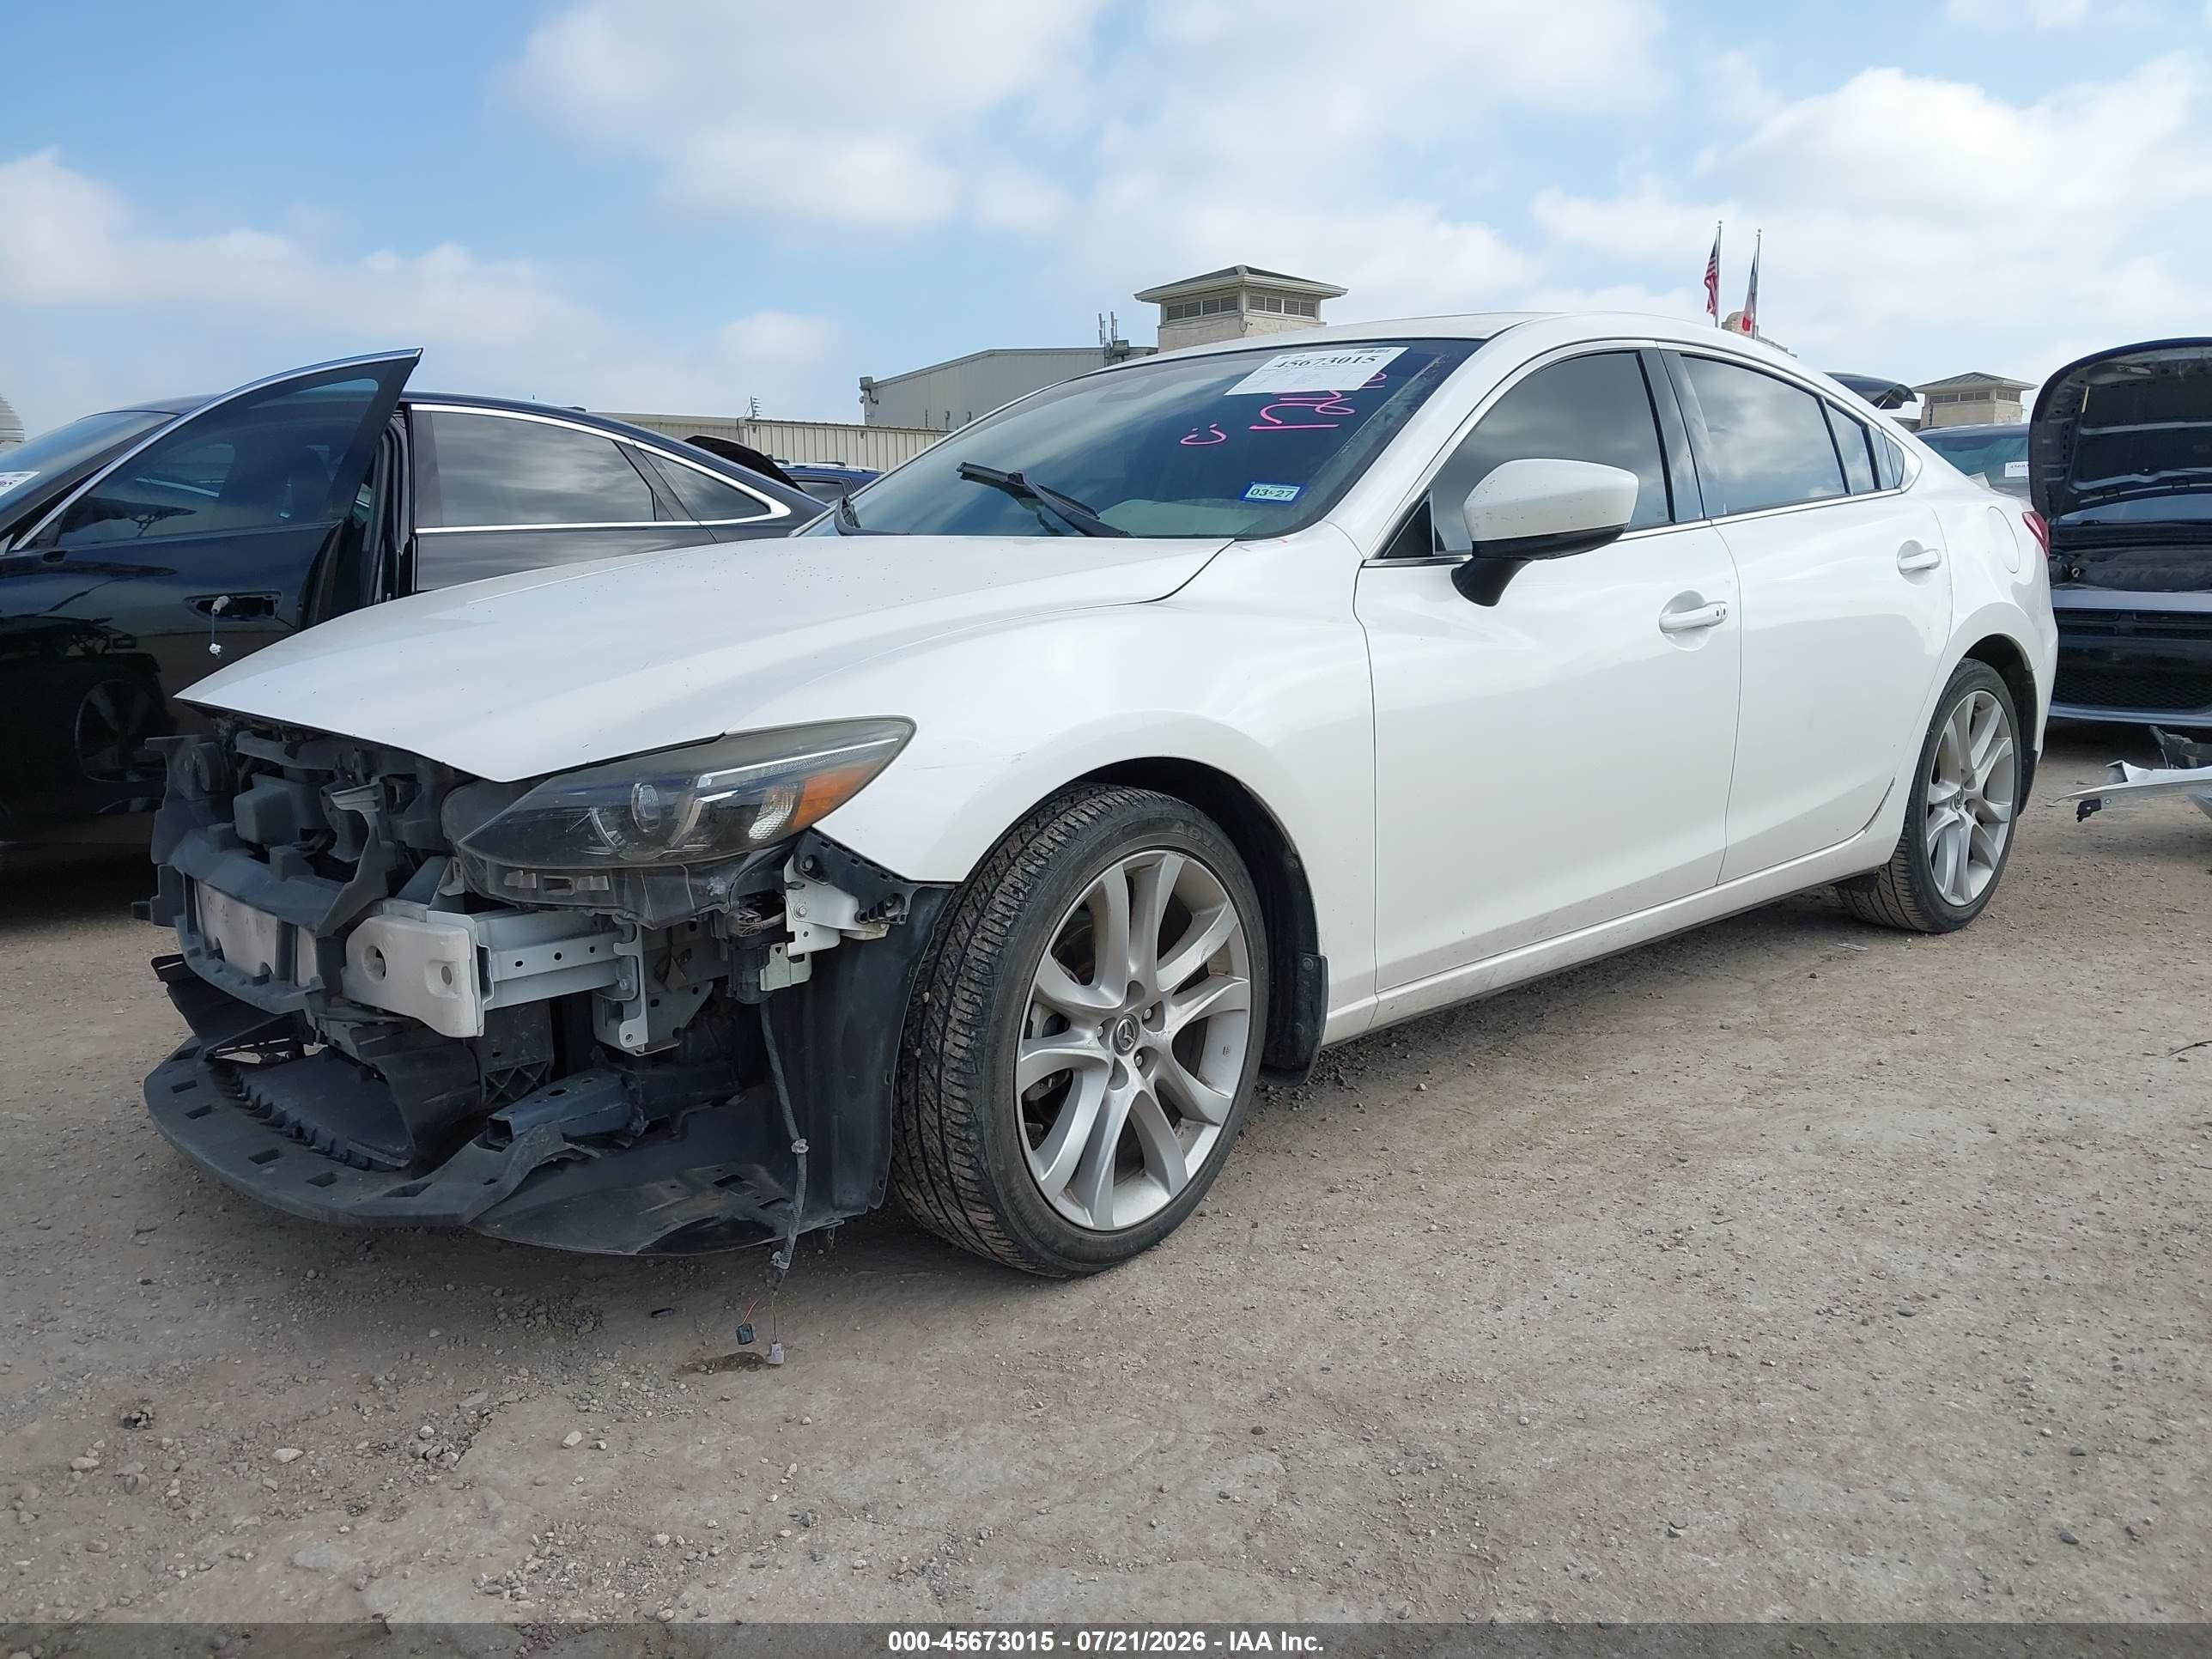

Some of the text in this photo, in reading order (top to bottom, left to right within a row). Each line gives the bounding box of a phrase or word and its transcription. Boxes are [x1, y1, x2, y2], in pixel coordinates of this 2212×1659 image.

[1273, 355, 1380, 368] 45673015
[1250, 488, 1296, 498] 03 27
